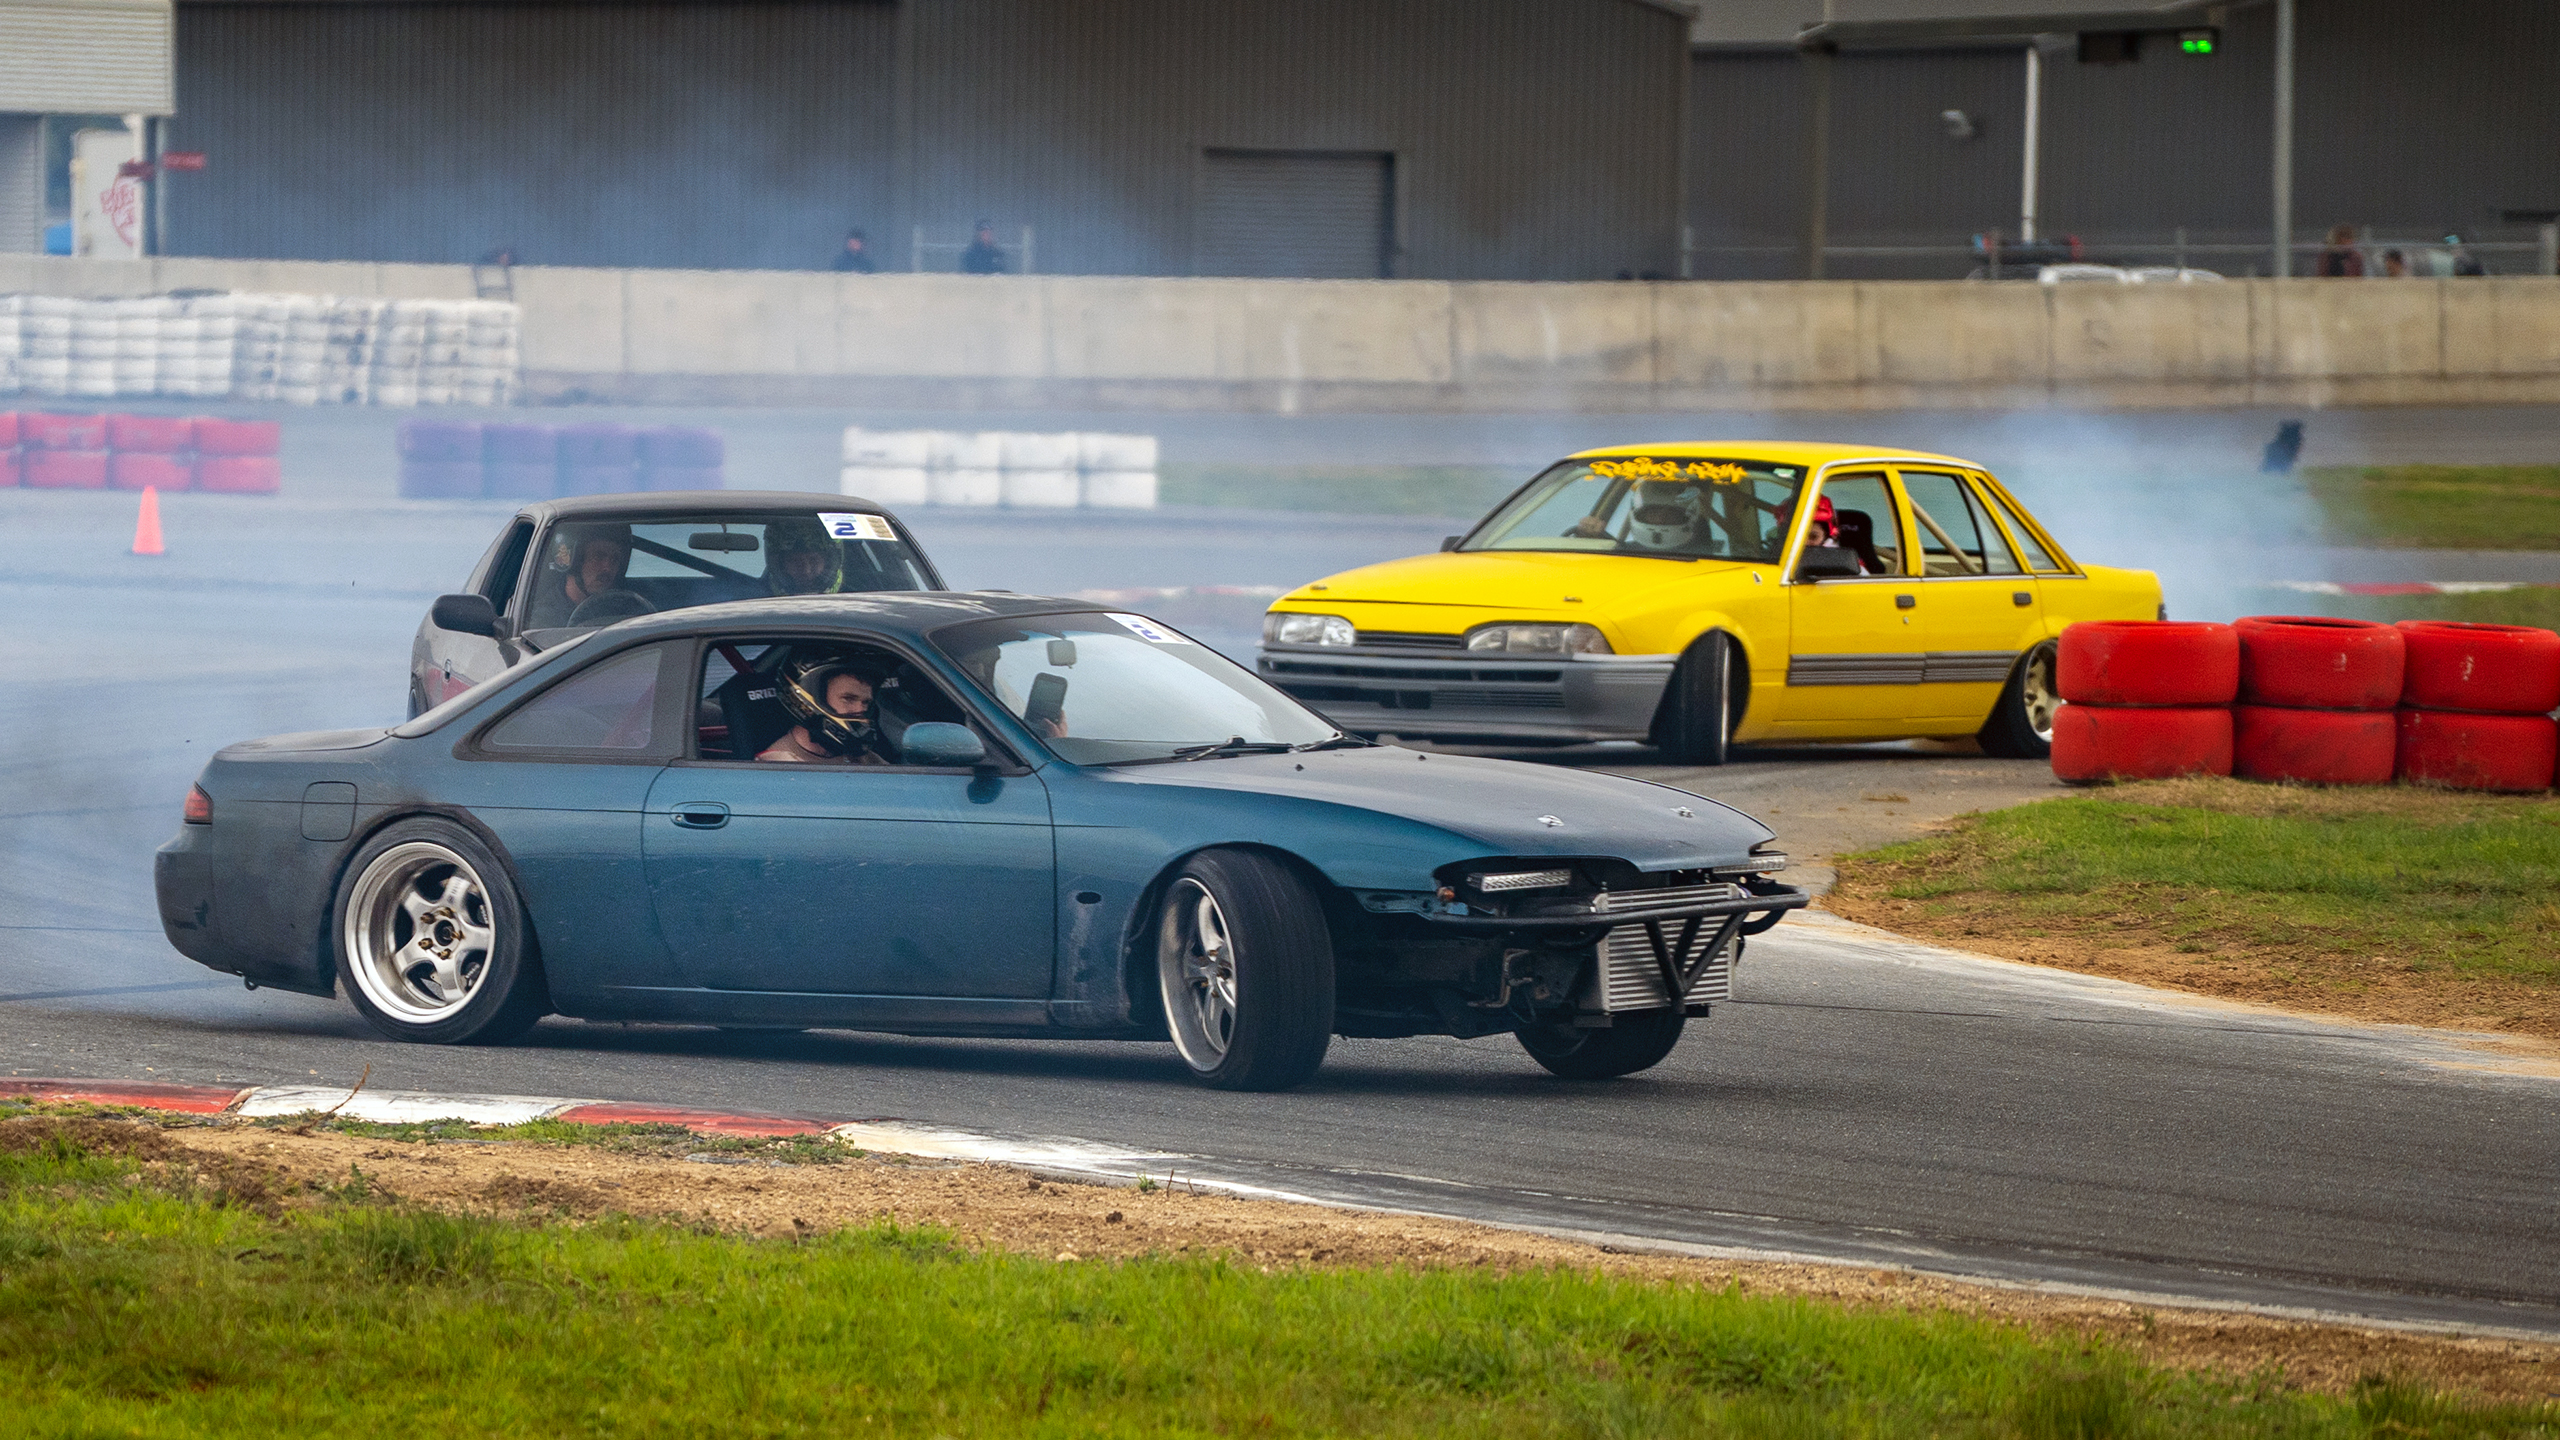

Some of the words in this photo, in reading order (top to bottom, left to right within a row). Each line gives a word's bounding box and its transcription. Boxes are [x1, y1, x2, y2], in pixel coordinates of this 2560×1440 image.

[834, 522, 857, 536] 2
[1131, 624, 1162, 640] 2
[747, 688, 777, 700] BRID
